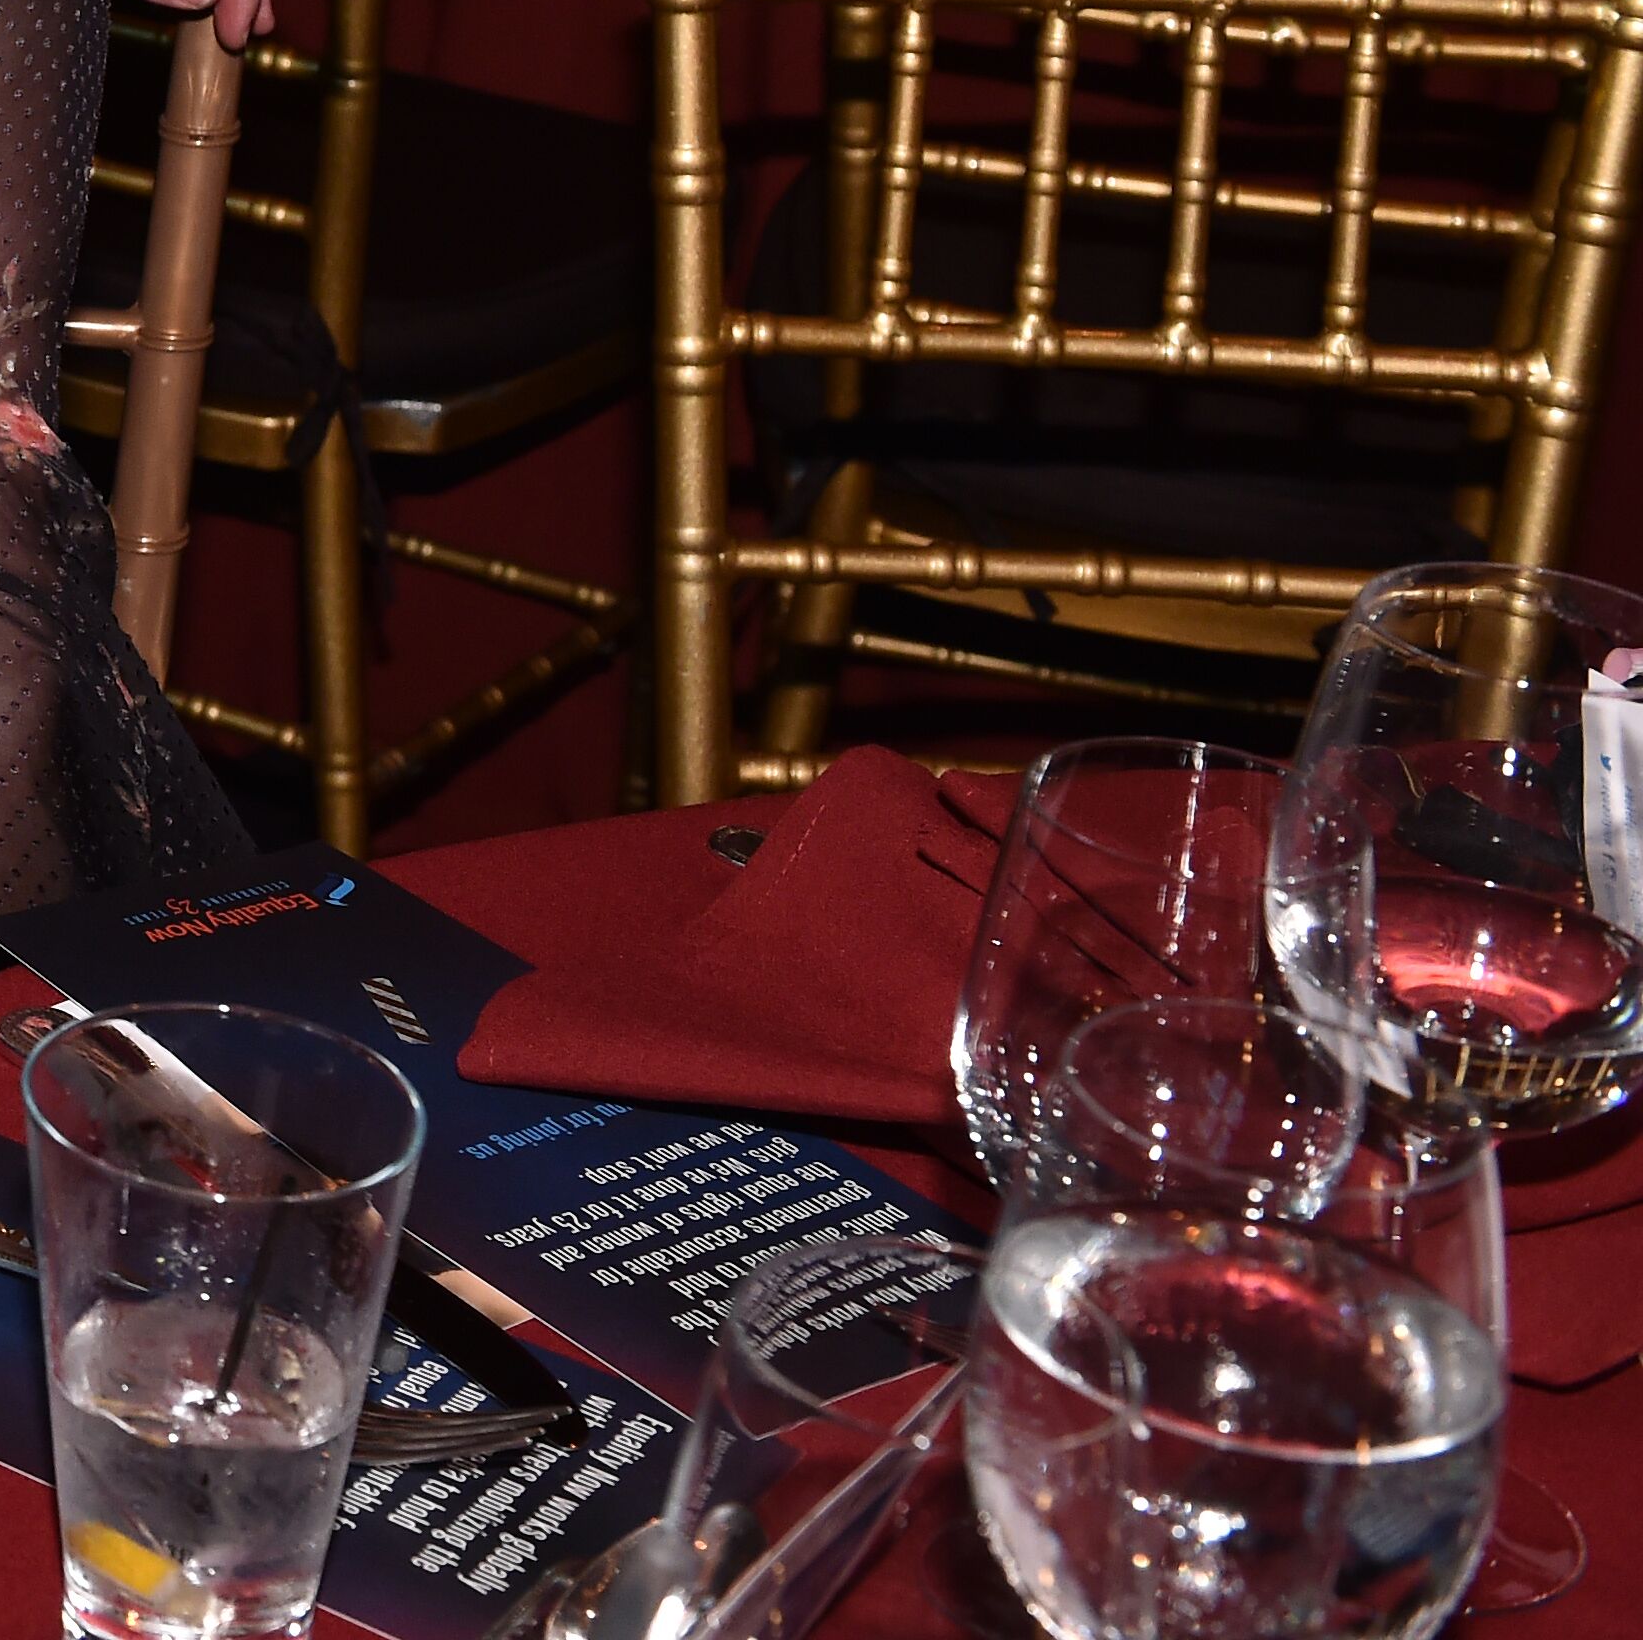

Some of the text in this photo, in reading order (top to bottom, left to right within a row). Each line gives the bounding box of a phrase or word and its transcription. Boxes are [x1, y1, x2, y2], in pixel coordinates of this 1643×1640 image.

[123, 881, 290, 925] CELEBRATING 25 YEARS
[145, 893, 319, 943] Equality Now
[459, 1102, 633, 1159] ou for joining us.
[688, 1131, 727, 1151] we
[578, 1161, 637, 1185] stop.
[629, 1143, 695, 1171] won't
[484, 1136, 800, 1249] girls. We've done it for 25 years,
[539, 1161, 840, 1272] the equal rights of women and
[589, 1179, 872, 1286] governments accountable for
[841, 1202, 910, 1236] public
[668, 1270, 729, 1300] hold
[716, 1261, 749, 1280] to
[670, 1309, 719, 1331] the
[805, 1300, 869, 1329] works
[395, 1360, 449, 1403] equal
[509, 1442, 570, 1483] tners
[421, 1478, 462, 1499] to
[456, 1413, 673, 1596] Equality Now works globally
[386, 1493, 446, 1534] hold
[430, 1476, 526, 1551] mobilizing
[410, 1543, 461, 1573] the
